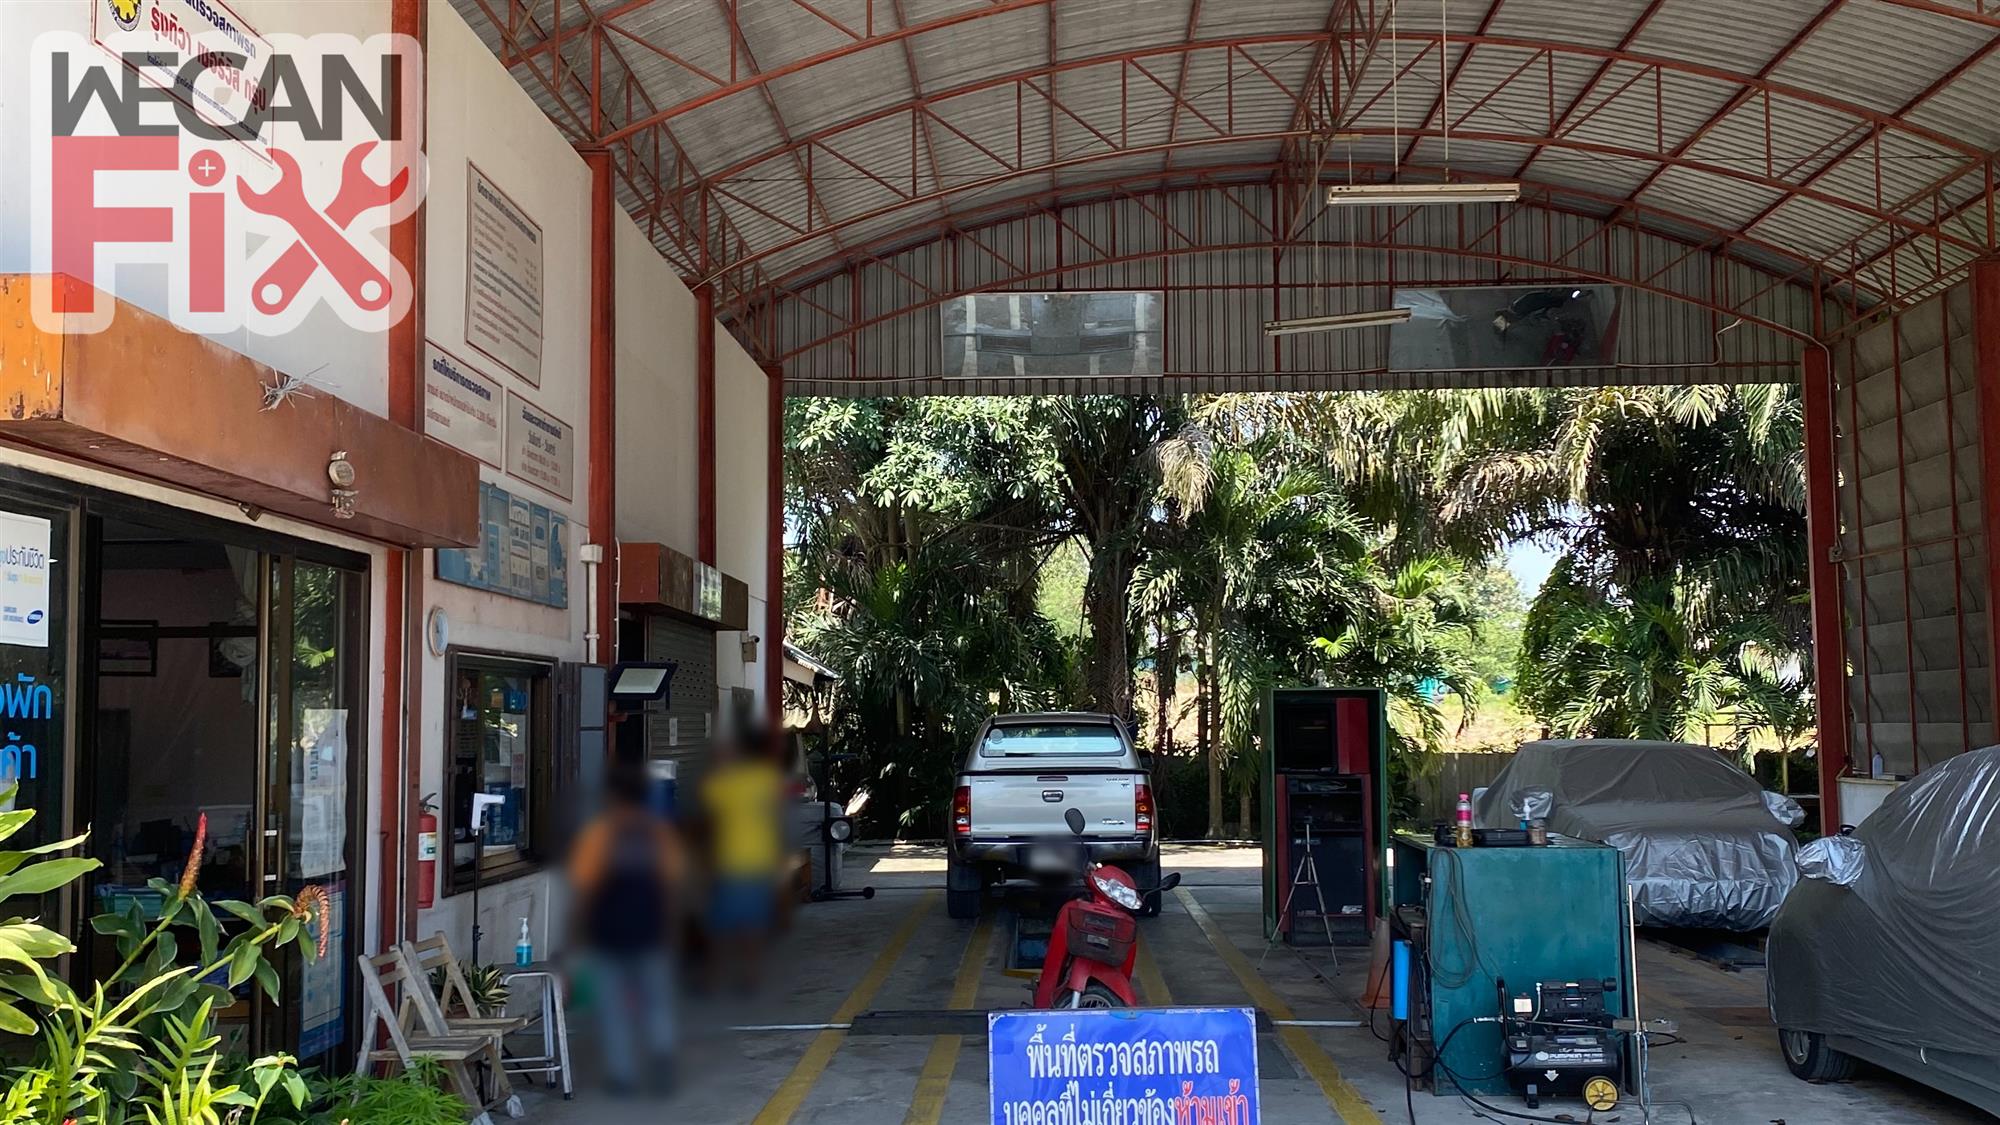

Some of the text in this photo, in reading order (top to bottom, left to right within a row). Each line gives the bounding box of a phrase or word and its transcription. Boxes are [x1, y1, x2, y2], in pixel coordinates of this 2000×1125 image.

[186, 0, 256, 59] ตรวจสภาพรถ
[0, 731, 36, 779] ค้า
[1026, 1024, 1219, 1078] พื้นที่ตรวจสภาพรถ
[1003, 1079, 1248, 1125] บคคลที่ไม่เกี่ยวข้องห้ามเข้า
